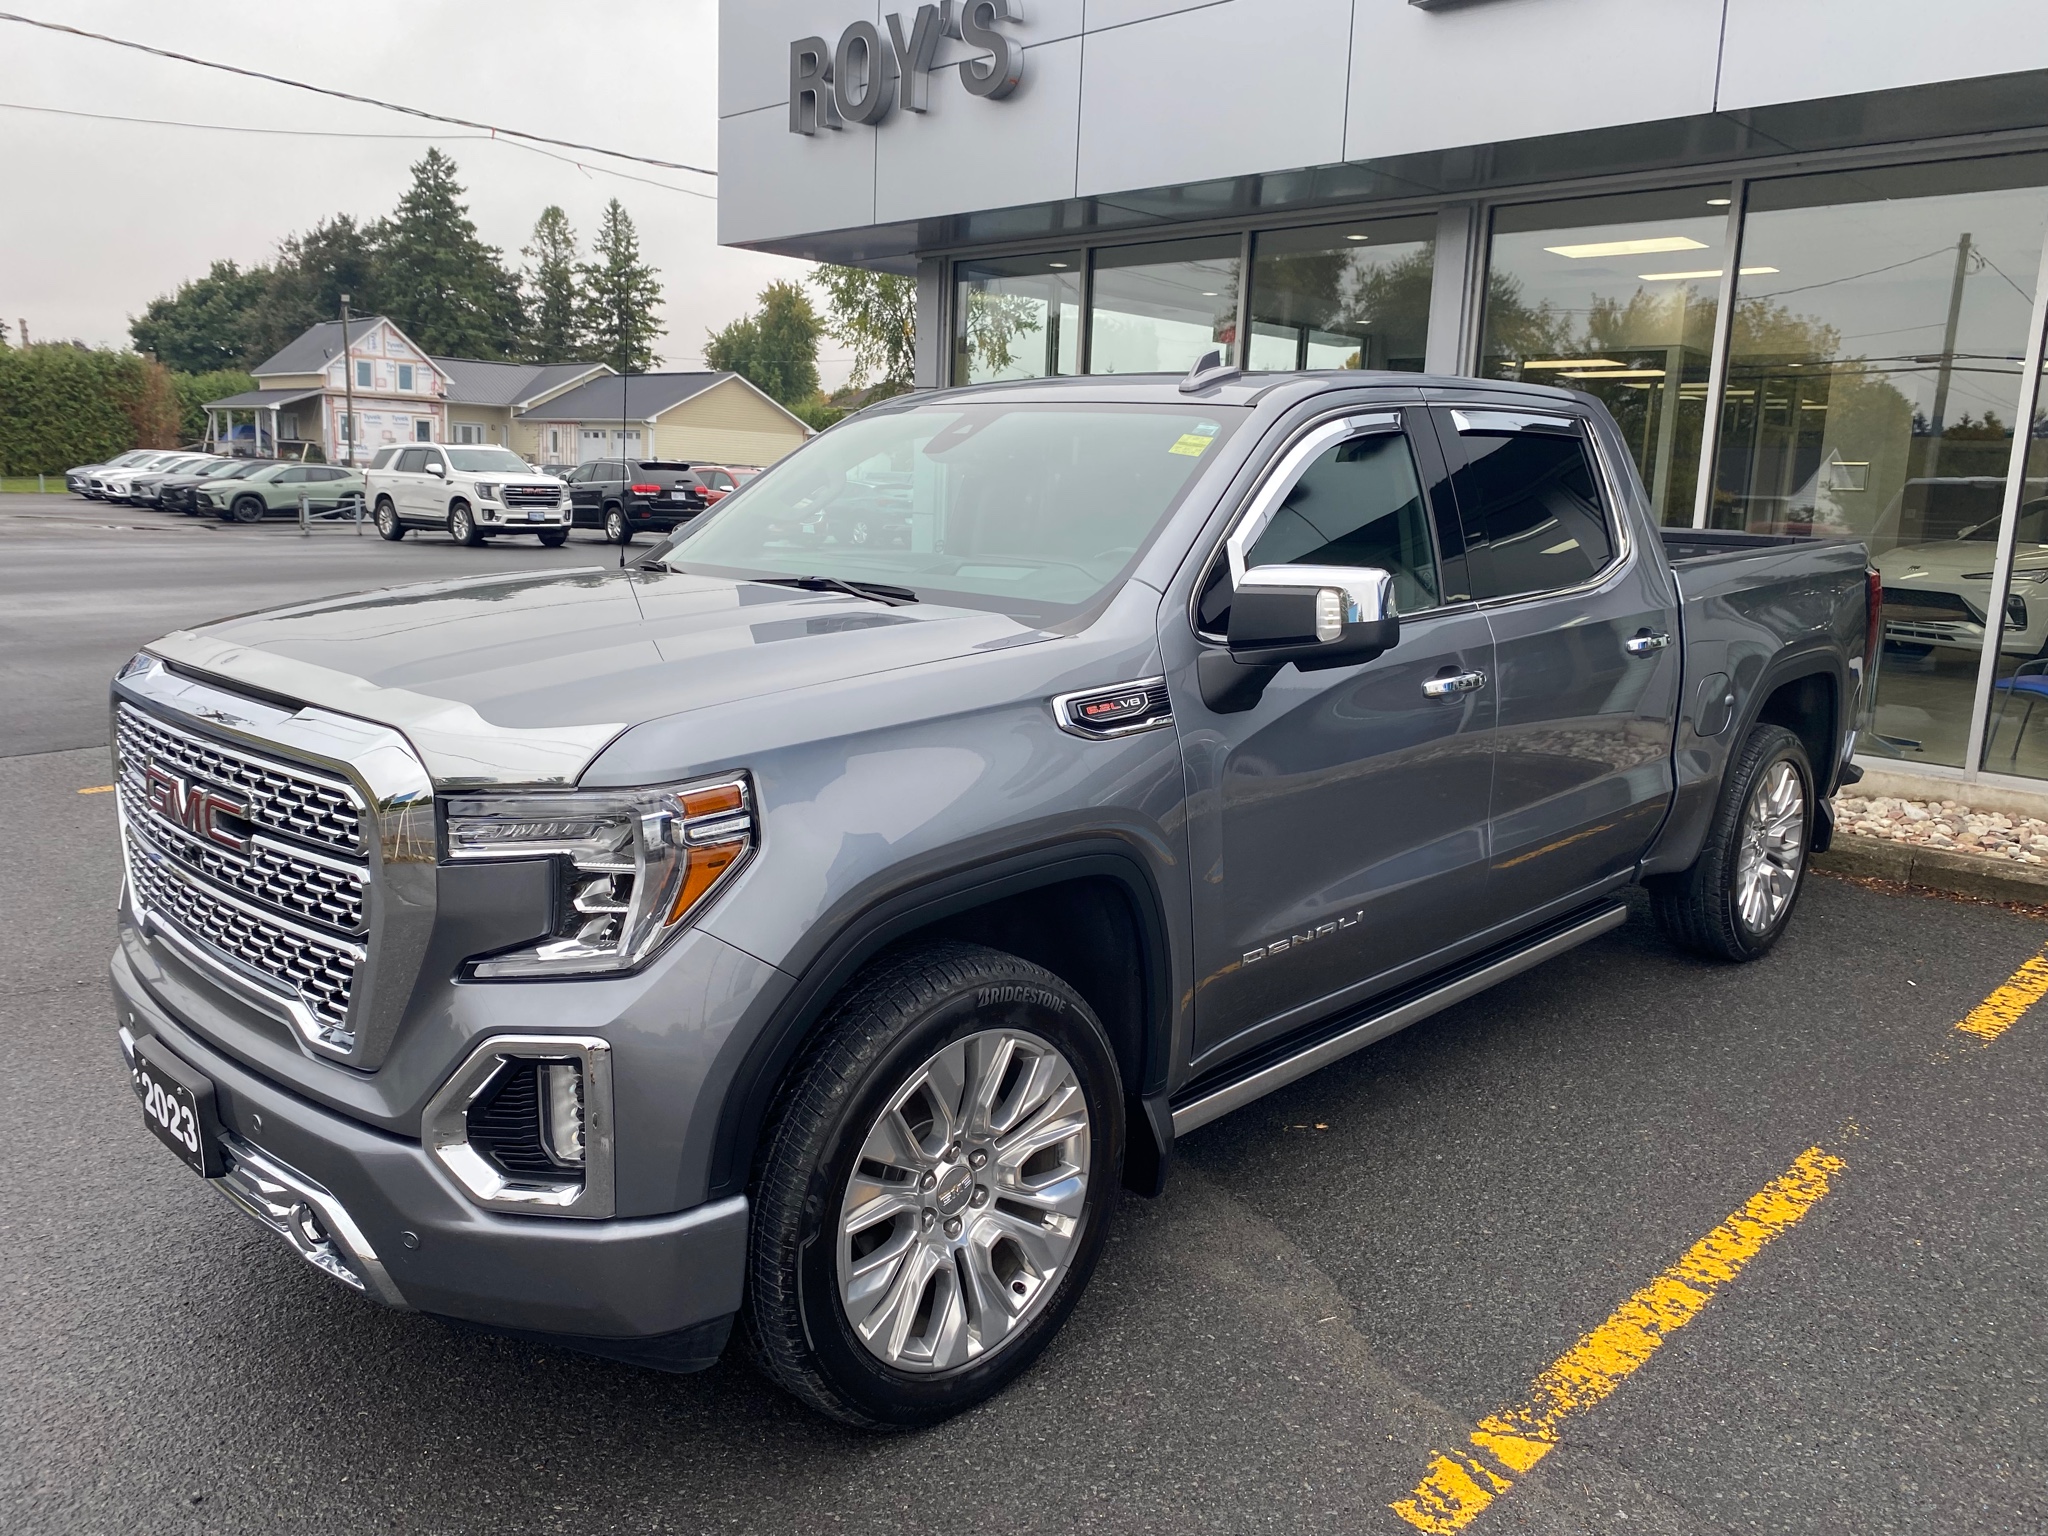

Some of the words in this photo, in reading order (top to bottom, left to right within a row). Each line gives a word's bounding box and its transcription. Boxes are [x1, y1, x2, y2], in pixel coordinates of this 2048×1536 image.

[789, 0, 1024, 136] ROY'S
[363, 413, 381, 421] Tyvek
[392, 414, 409, 422] Tyvek
[522, 487, 547, 495] GMC
[145, 764, 251, 855] GMC
[1241, 910, 1364, 967] DENALI
[978, 985, 1067, 1014] BRIDGESTONE
[141, 1072, 198, 1153] 2023
[939, 1173, 972, 1207] GMC
